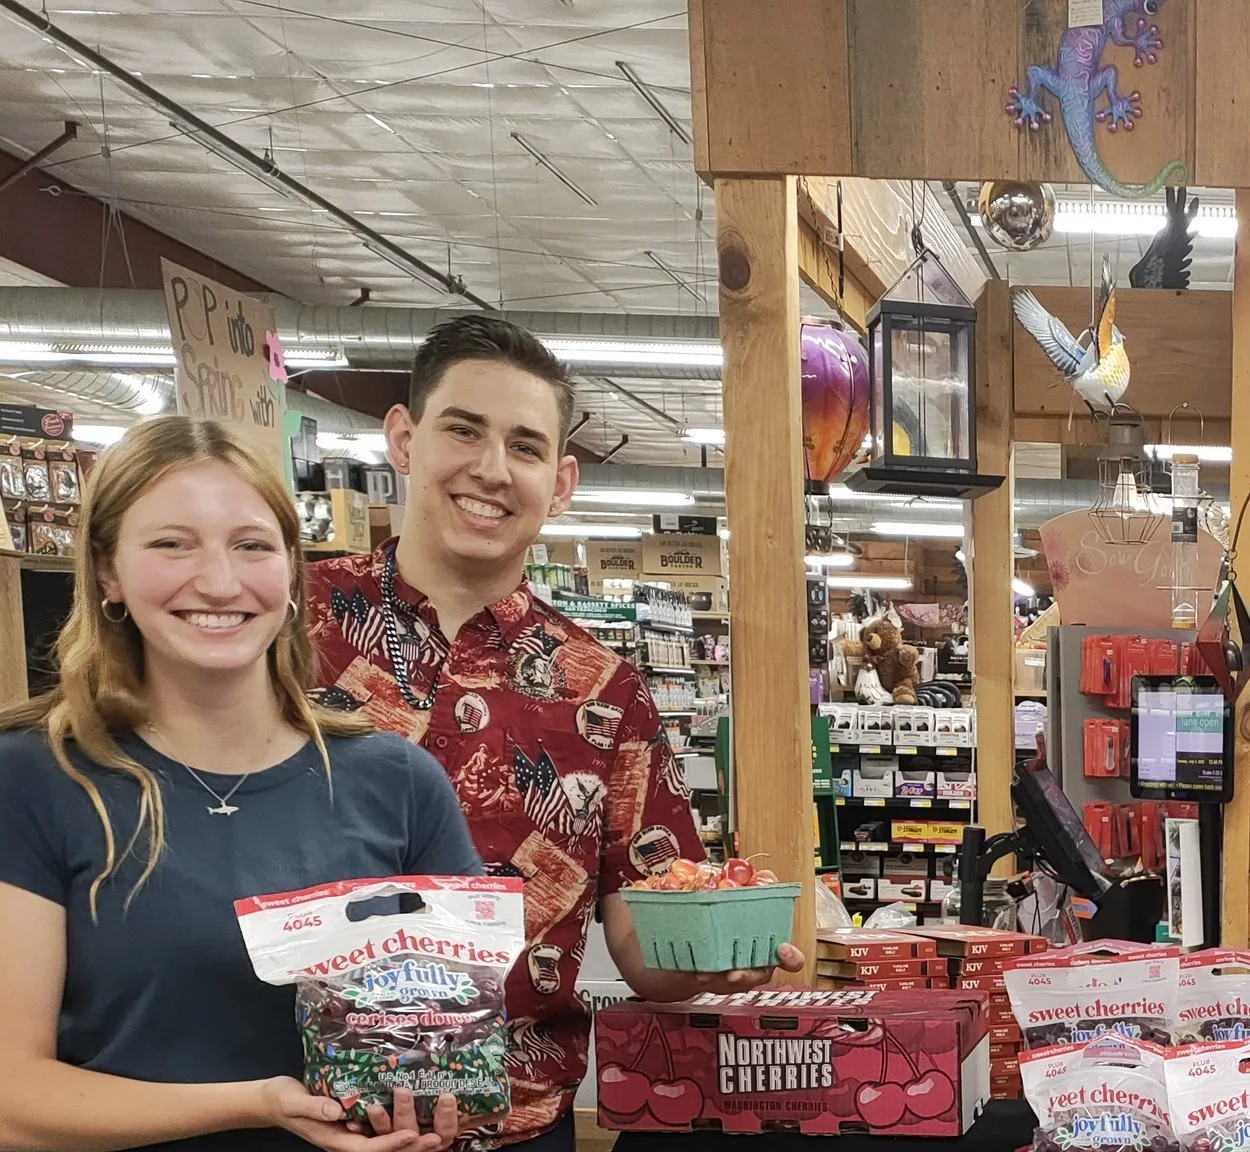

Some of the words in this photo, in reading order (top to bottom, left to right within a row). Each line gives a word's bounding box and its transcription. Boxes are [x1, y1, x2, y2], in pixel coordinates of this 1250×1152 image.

[225, 300, 254, 358] into
[250, 385, 275, 428] with
[601, 559, 635, 571] BOULDER
[660, 554, 703, 569] BOULDER
[1182, 716, 1198, 728] lane
[1199, 717, 1219, 730] open
[470, 882, 507, 891] cherries
[261, 896, 295, 909] sweet
[283, 915, 323, 933] 4045
[382, 928, 511, 965] cherries
[851, 947, 869, 957] KJV
[972, 944, 988, 954] KJV
[861, 965, 880, 975] KJV
[966, 963, 983, 972] KJV
[364, 960, 460, 993] joyfully
[1028, 977, 1052, 986] 4045
[962, 980, 980, 990] KJV
[399, 986, 449, 1002] grown
[1028, 1001, 1081, 1023] sweet
[1085, 996, 1165, 1017] cherries
[1178, 1000, 1223, 1022] sweet
[345, 1011, 418, 1027] cerises
[719, 1033, 833, 1066] NORTHWEST
[1051, 1044, 1075, 1054] cherries
[1046, 1066, 1067, 1079] 4045
[1188, 1064, 1216, 1077] 4045
[719, 1063, 833, 1095] CHERRIES
[724, 1100, 783, 1112] WASHINGTON
[785, 1101, 828, 1113] CHERRIES
[1090, 1082, 1170, 1126] cherries
[1188, 1089, 1249, 1127] sweet
[1071, 1114, 1142, 1138] joyfully
[1093, 1135, 1131, 1148] grown
